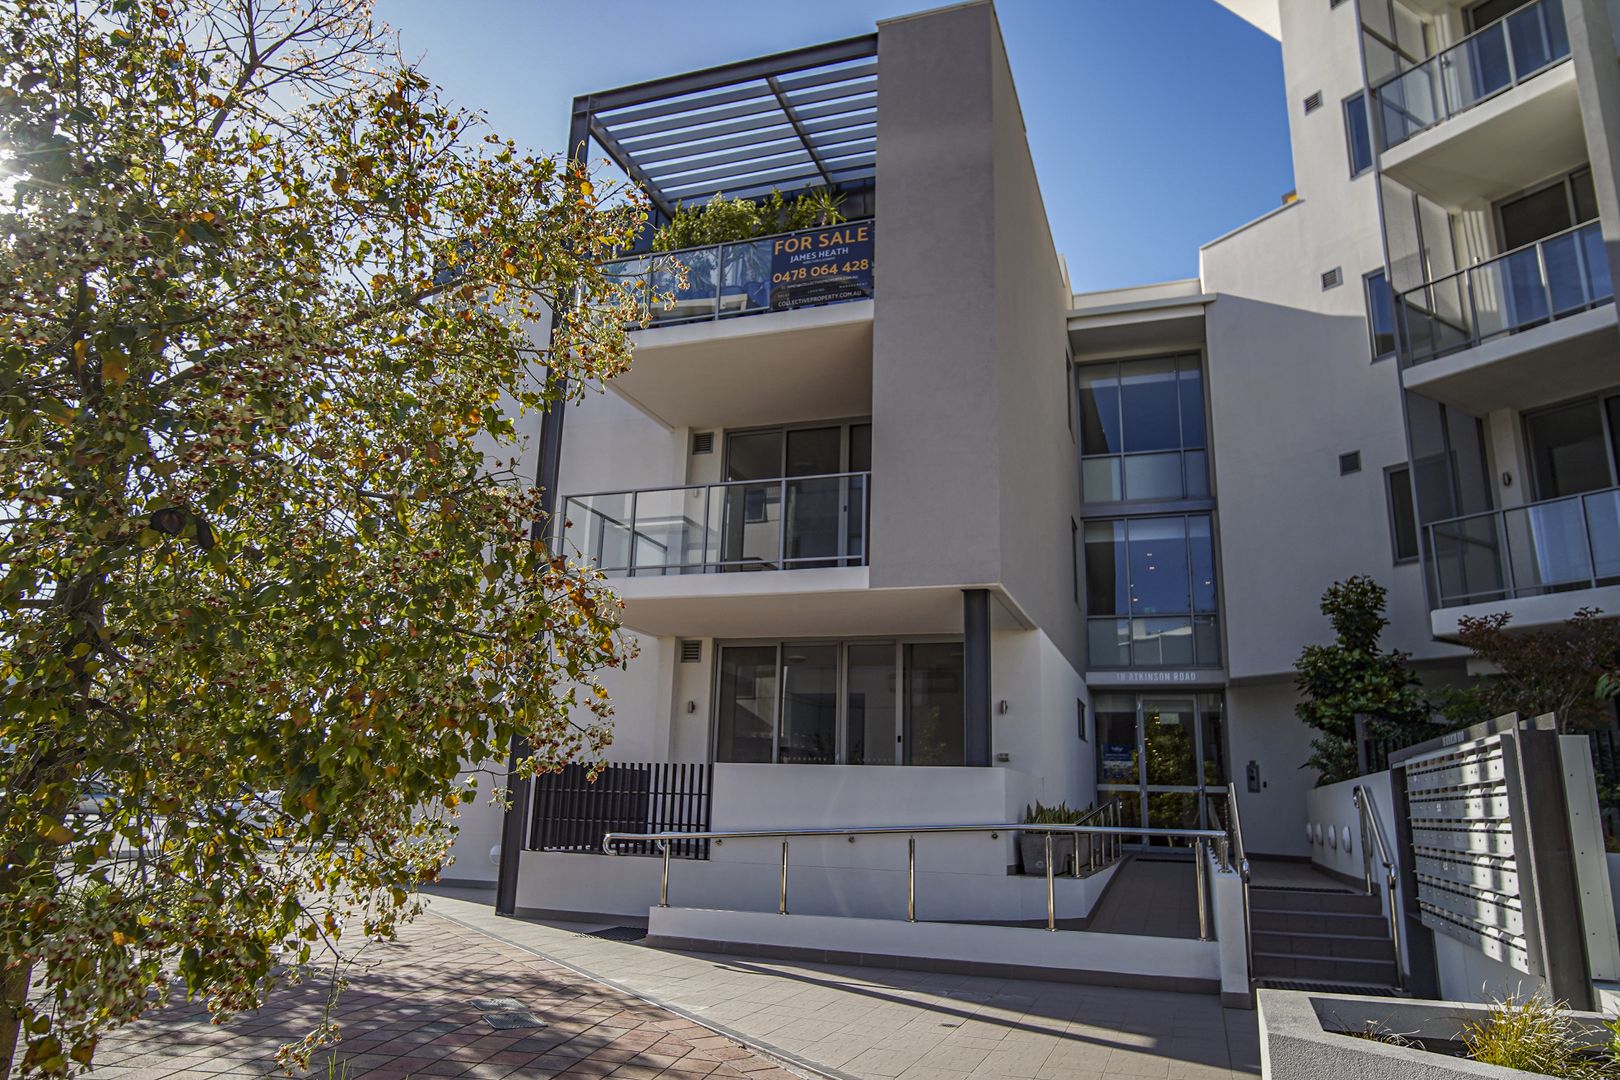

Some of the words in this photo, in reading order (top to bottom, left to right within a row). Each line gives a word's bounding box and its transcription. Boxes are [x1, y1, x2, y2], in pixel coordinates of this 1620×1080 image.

[774, 236, 812, 255] FOR
[818, 227, 869, 247] SALE
[790, 251, 817, 263] JAMES
[818, 247, 849, 258] HEATH
[772, 267, 807, 283] 0478
[810, 263, 838, 276] 064
[842, 258, 869, 273] 428
[1128, 672, 1171, 681] ATKINSON
[1173, 672, 1196, 681] ROAD
